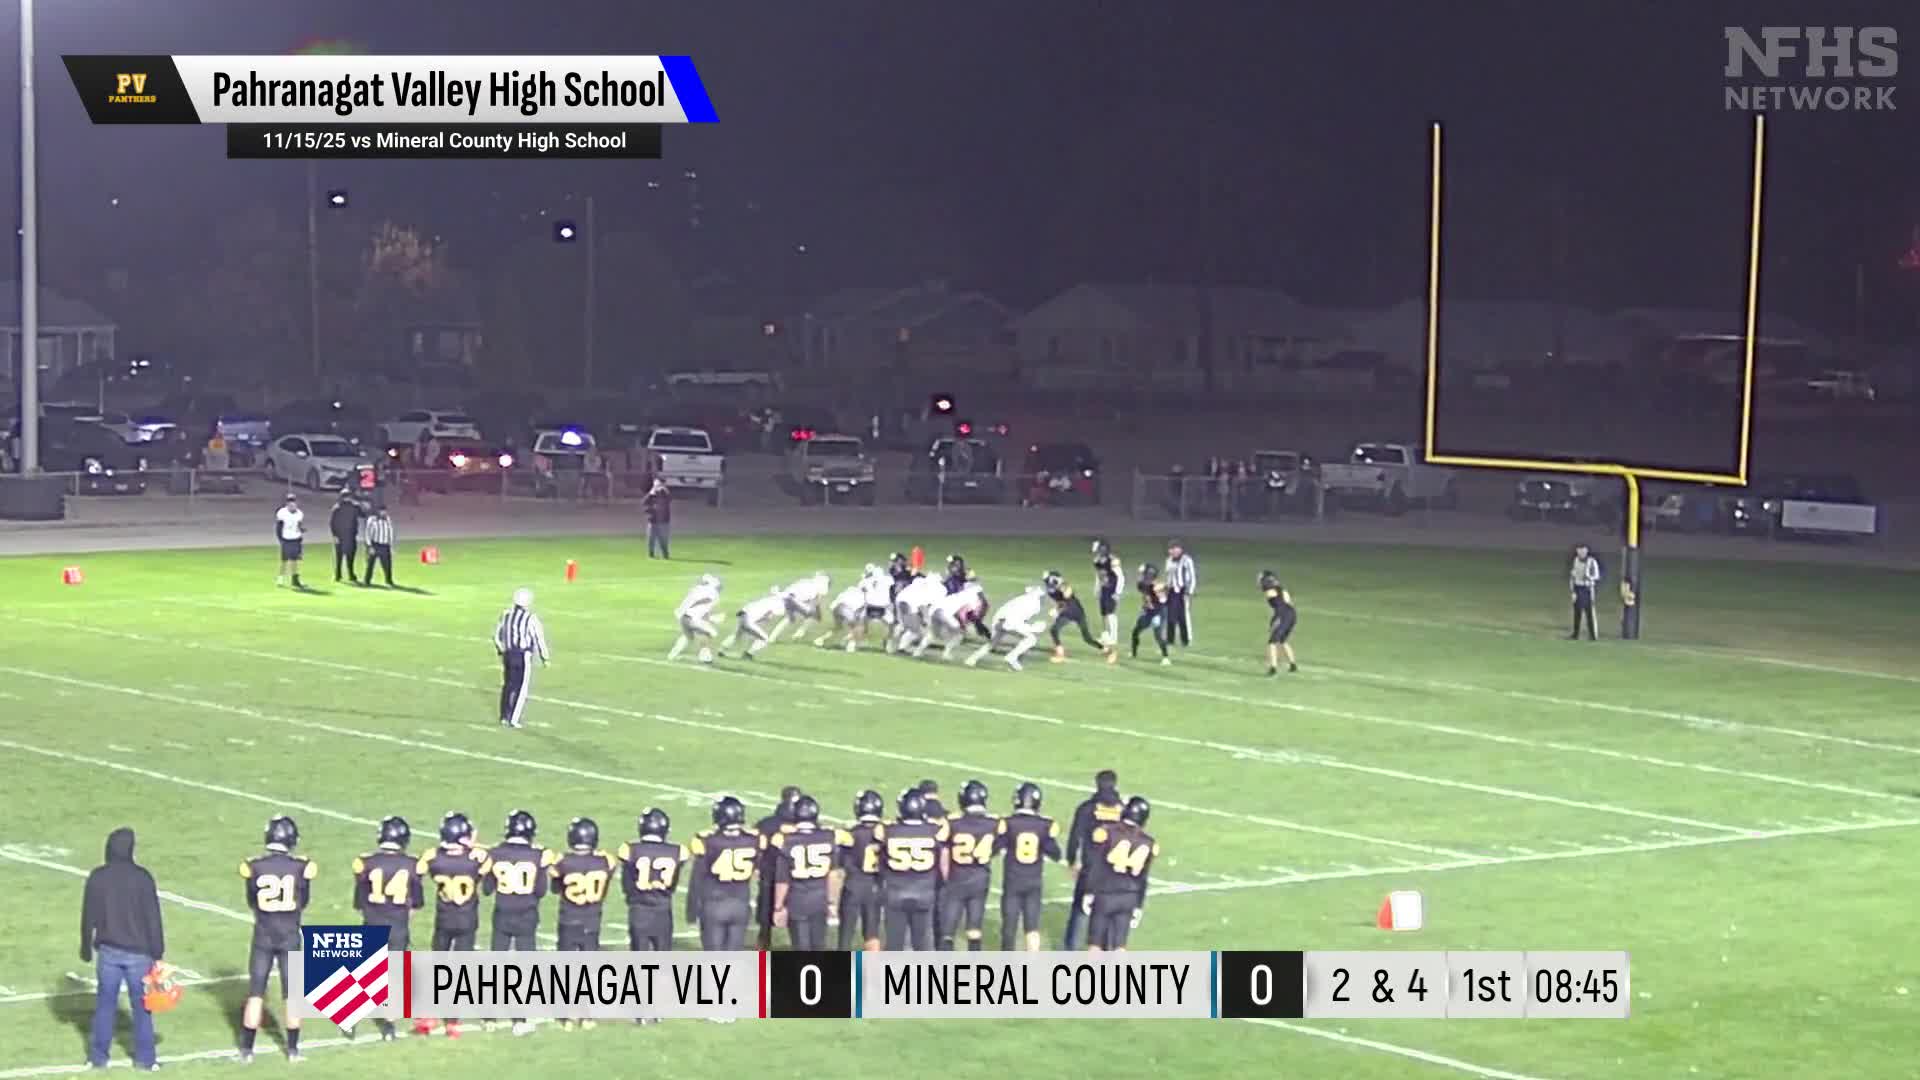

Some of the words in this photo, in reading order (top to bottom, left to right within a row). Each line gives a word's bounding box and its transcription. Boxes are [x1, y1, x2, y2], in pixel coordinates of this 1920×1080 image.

[711, 847, 757, 882] 45
[789, 843, 833, 880] 15
[888, 836, 935, 872] 55
[952, 833, 995, 865] 24
[1016, 831, 1039, 864] 8
[1106, 839, 1150, 877] 44
[367, 868, 410, 906] 14
[563, 869, 608, 906] 20
[635, 856, 677, 891] 13
[255, 873, 297, 913] 21
